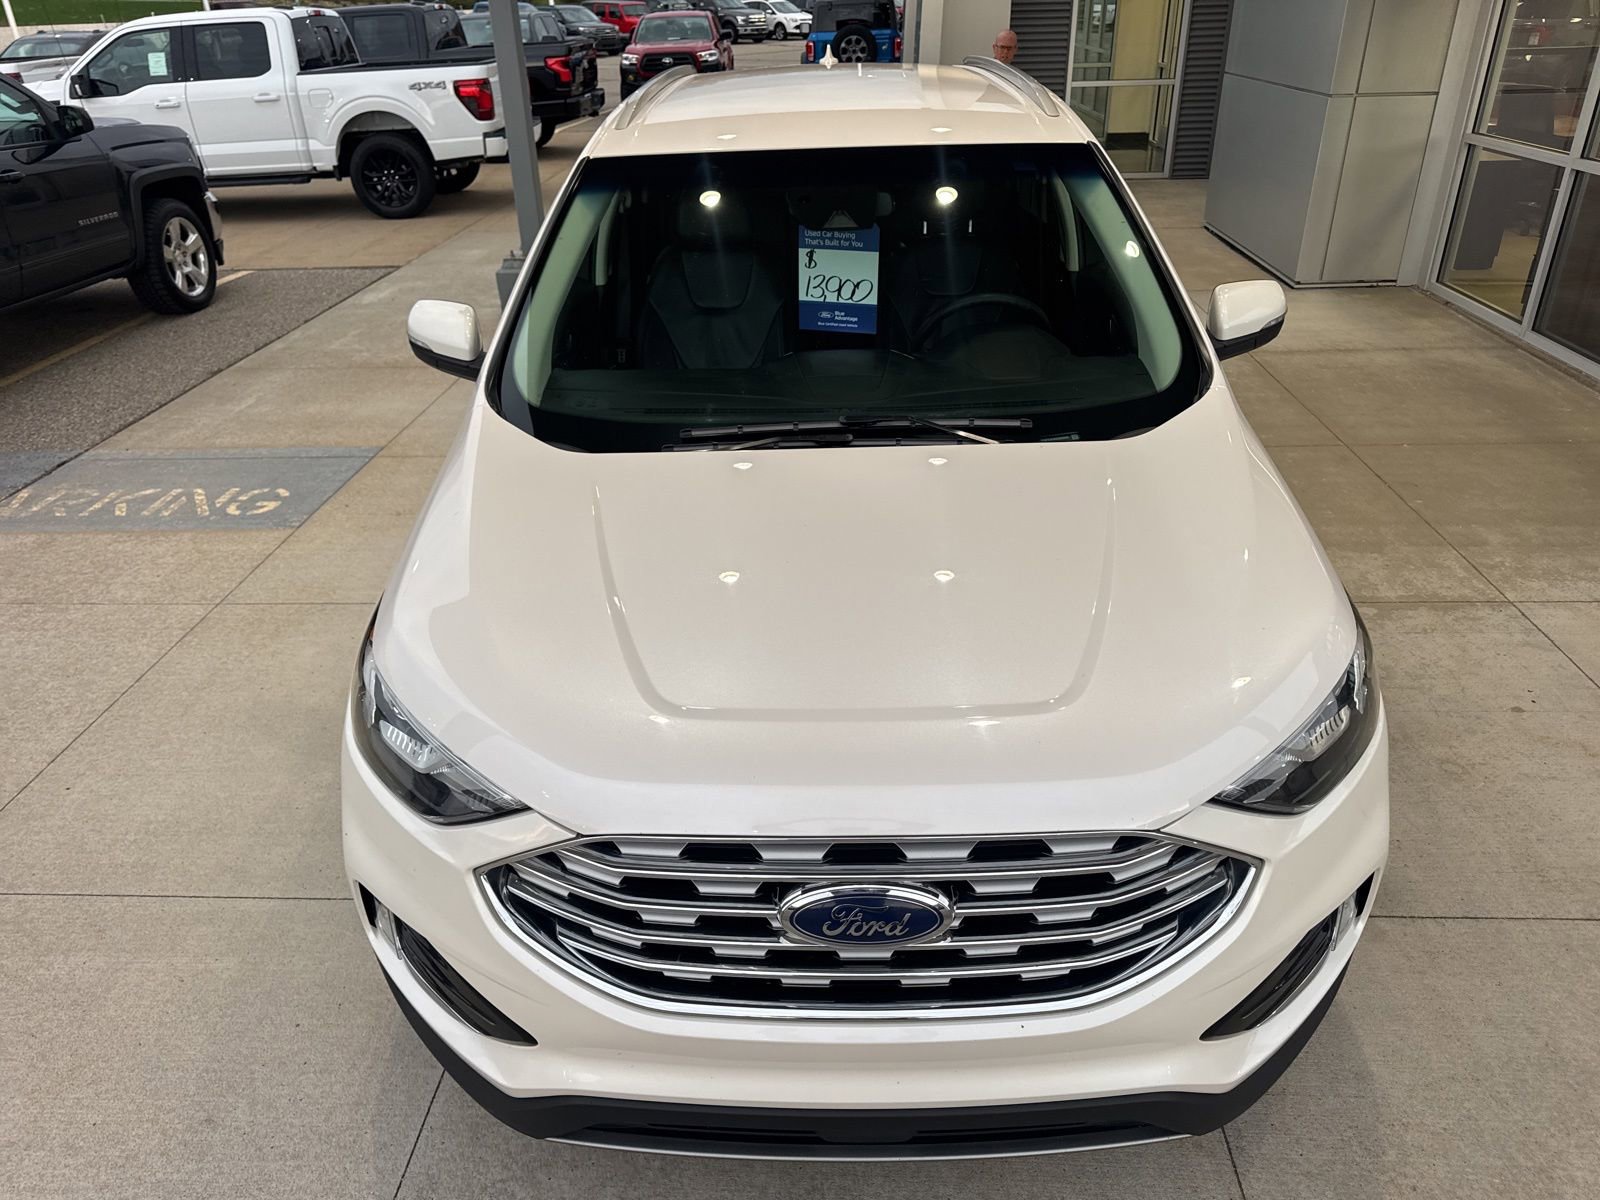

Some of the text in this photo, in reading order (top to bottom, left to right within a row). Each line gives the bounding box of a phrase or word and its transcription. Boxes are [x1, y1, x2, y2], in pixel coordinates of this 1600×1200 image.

[805, 238, 864, 248] That's Built for You
[834, 231, 856, 240] Buying
[805, 248, 817, 269] $
[806, 274, 874, 303] 13,900
[822, 903, 912, 936] Ford
